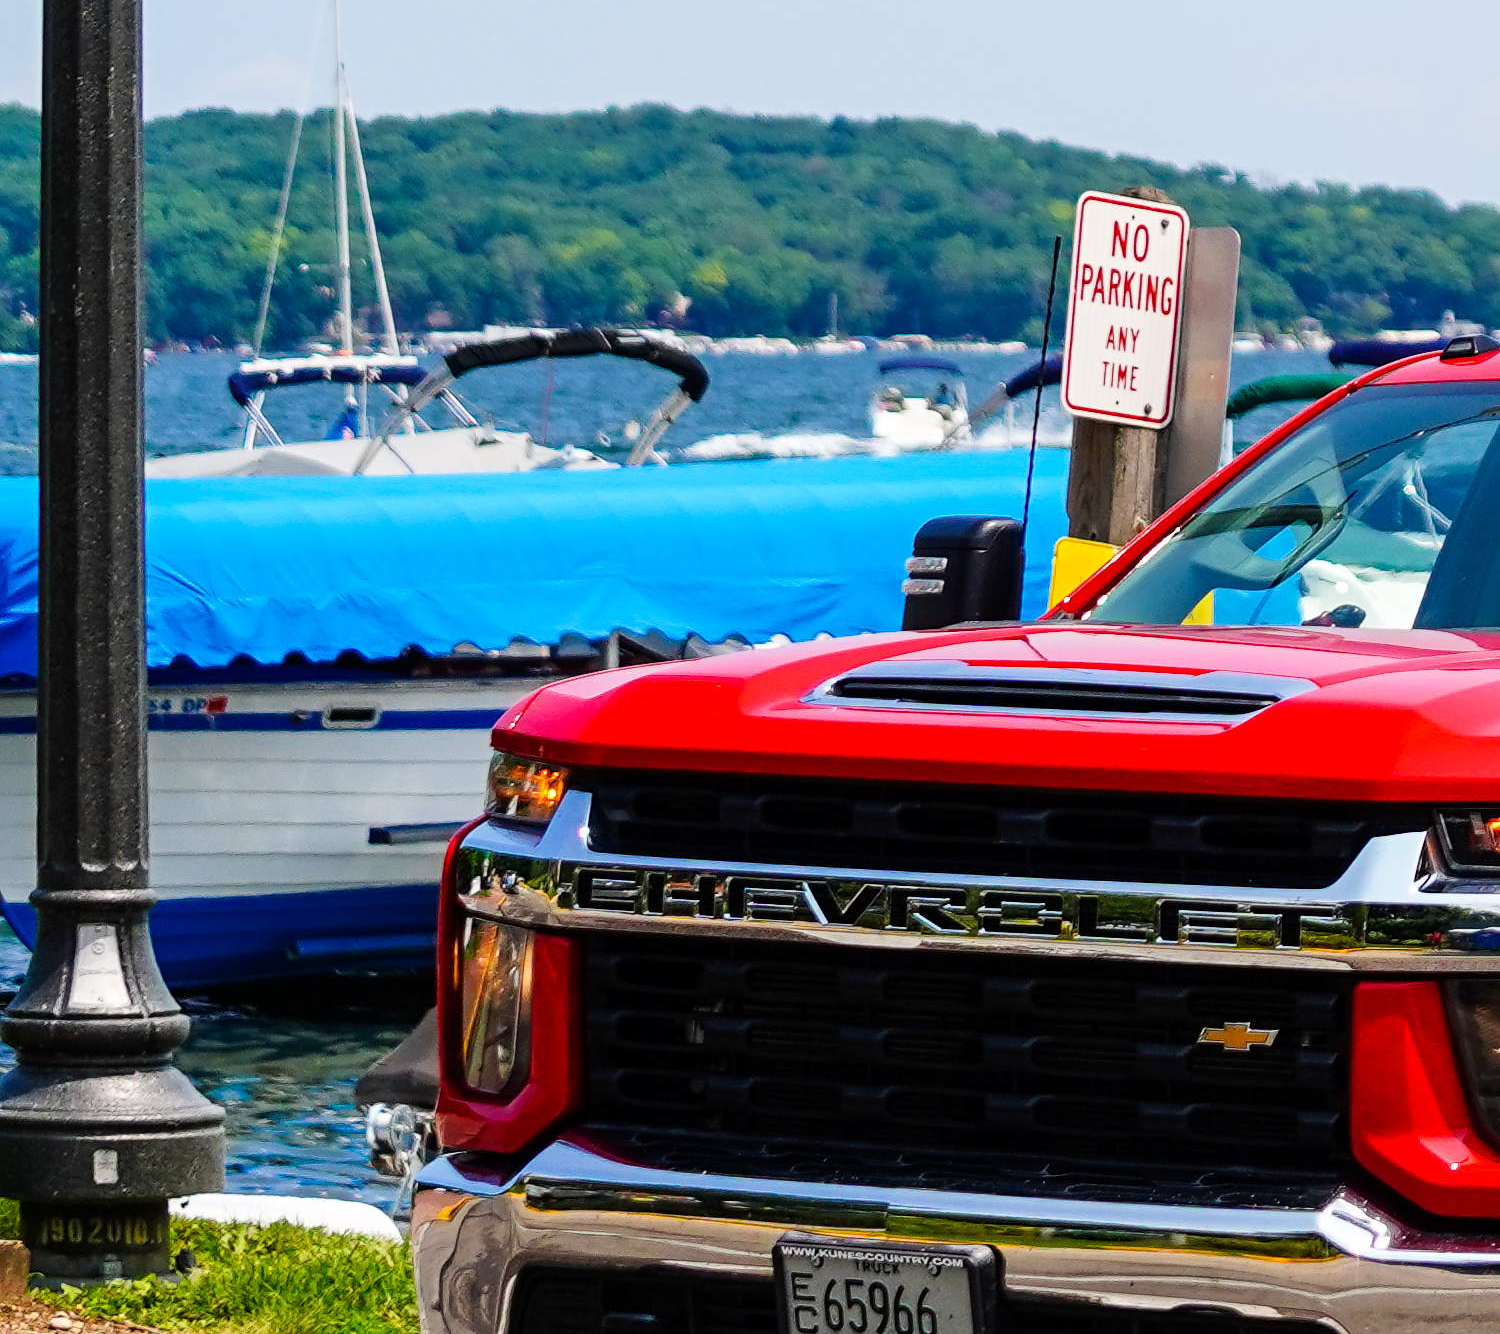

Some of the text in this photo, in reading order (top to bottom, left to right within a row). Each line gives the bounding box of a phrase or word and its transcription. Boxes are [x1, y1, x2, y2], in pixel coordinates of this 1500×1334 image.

[1111, 220, 1149, 262] NO
[1080, 263, 1173, 315] PARKING
[1105, 325, 1140, 353] ANY
[1102, 361, 1139, 391] TIME
[573, 866, 1345, 951] CHEVROLET
[780, 1245, 964, 1267] WWW.KUNESCOUNTRY.COM
[854, 1261, 901, 1276] TRUCK
